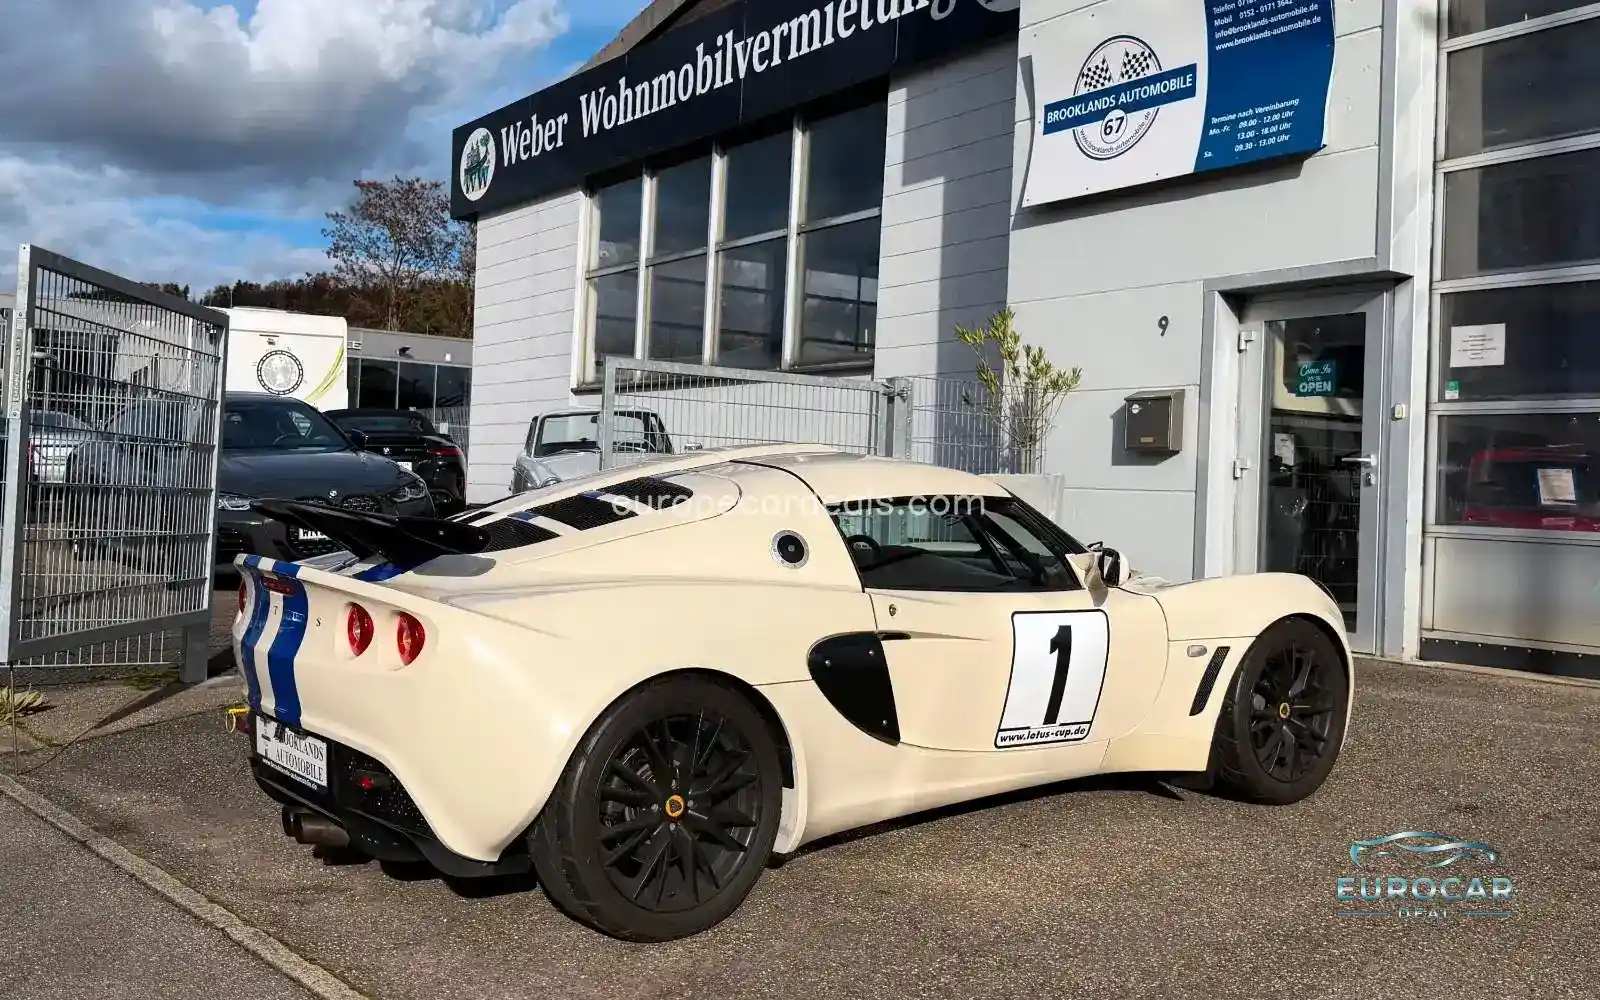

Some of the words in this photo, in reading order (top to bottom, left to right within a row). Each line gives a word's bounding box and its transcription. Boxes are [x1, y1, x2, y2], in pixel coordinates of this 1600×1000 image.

[1213, 2, 1236, 15] Telefon
[1214, 15, 1233, 27] Mobil
[1239, 8, 1255, 19] 0152
[1260, 2, 1276, 13] 0171
[1214, 3, 1319, 39] info@brooklands-automobile.de
[1215, 15, 1322, 51] www.brooklands-automobile.de
[1047, 94, 1116, 124] BROOKLANDS
[1118, 74, 1193, 106] AUTOMOBILE
[1211, 113, 1236, 125] Termine
[1237, 109, 1253, 118] nach
[1255, 98, 1300, 114] Vereinbarung
[1238, 118, 1257, 129] 09.00
[1263, 113, 1281, 123] 12.00
[1281, 110, 1295, 119] Uhr
[1103, 116, 1125, 136] 67
[1237, 130, 1255, 140] 13.00
[1261, 125, 1278, 135] 18.00
[1279, 122, 1292, 131] Uhr
[500, 111, 568, 167] Weber
[1234, 142, 1253, 152] 09.30
[1259, 136, 1276, 147] 13.00
[1277, 134, 1291, 143] Uhr
[1157, 315, 1169, 337] 9
[1300, 364, 1320, 376] Come
[1320, 364, 1332, 374] In
[1299, 381, 1332, 393] OPEN
[1043, 624, 1072, 726] 1
[279, 727, 324, 762] OOKLANDS
[1001, 726, 1086, 743] www.lotus-cup.de
[276, 747, 324, 782] AUTOMOBILE
